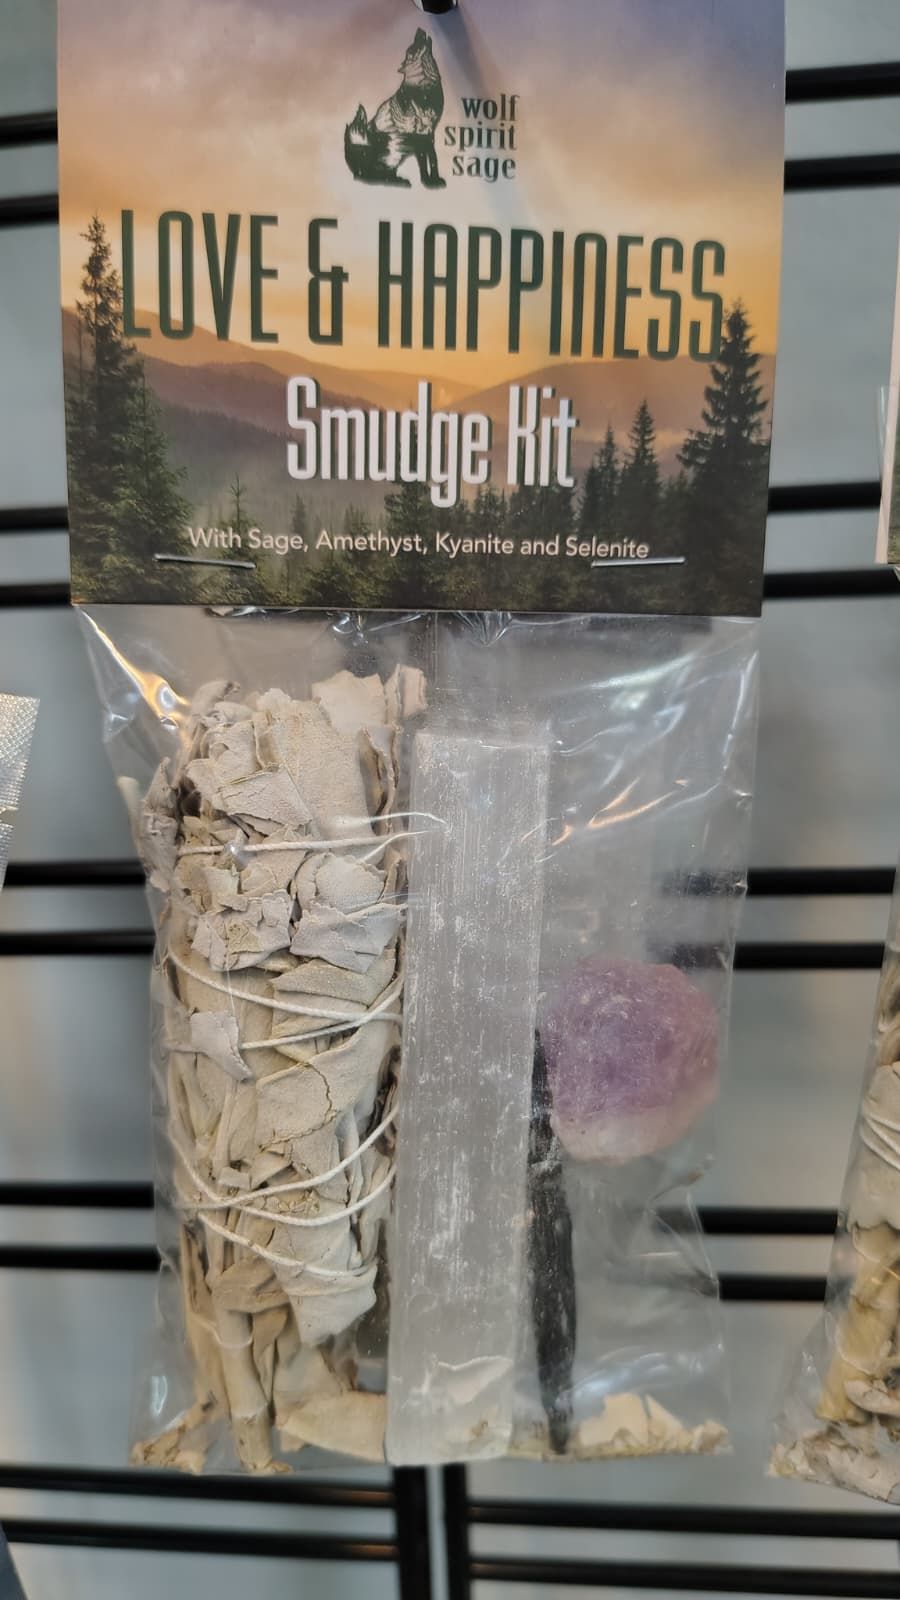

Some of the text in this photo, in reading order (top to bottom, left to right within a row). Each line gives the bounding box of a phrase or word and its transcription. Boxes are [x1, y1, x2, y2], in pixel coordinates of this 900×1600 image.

[461, 94, 520, 122] wolf
[444, 121, 518, 151] spirit
[452, 155, 516, 183] sage
[120, 209, 726, 362] LOVE & HAPPINESS
[287, 376, 577, 508] Smudge Kit
[188, 527, 649, 559] With Sage, Amethyst, Kyanite and Selenite
